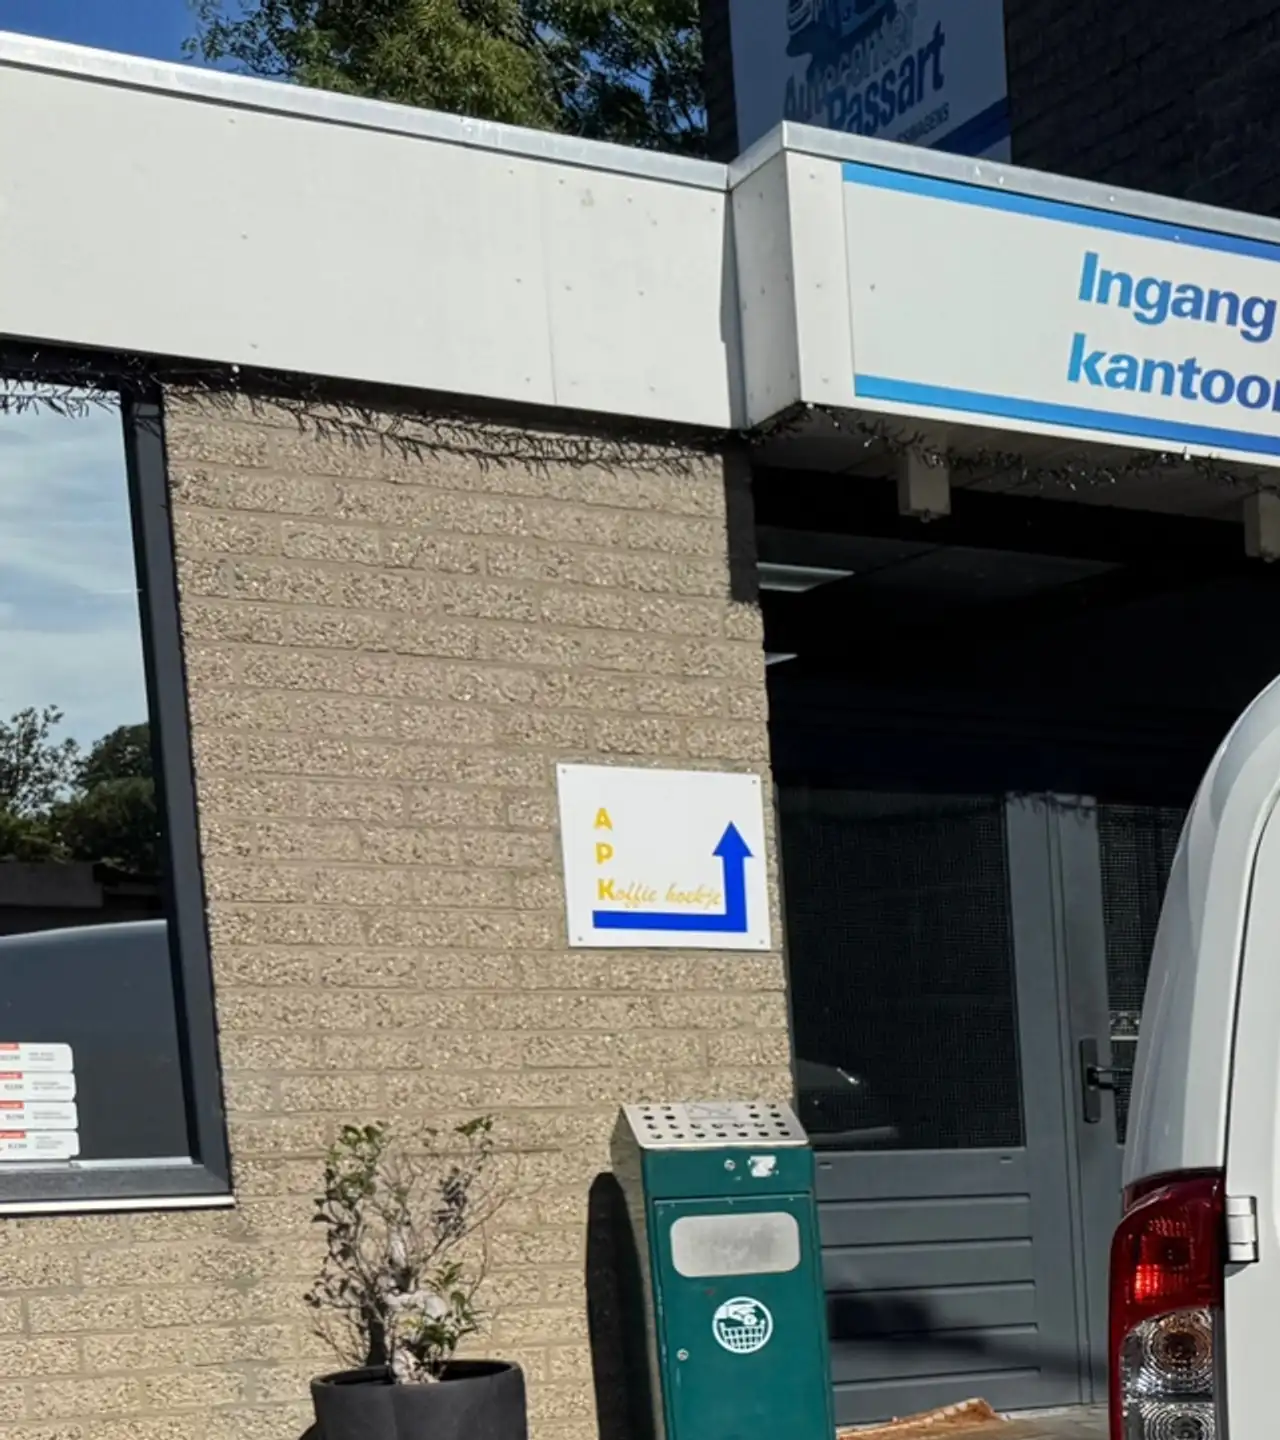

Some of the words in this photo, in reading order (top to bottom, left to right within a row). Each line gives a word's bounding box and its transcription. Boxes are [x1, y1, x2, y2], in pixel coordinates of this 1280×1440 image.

[783, 2, 918, 123] Autocenter
[826, 20, 945, 136] Passart
[1079, 251, 1278, 343] Ingang
